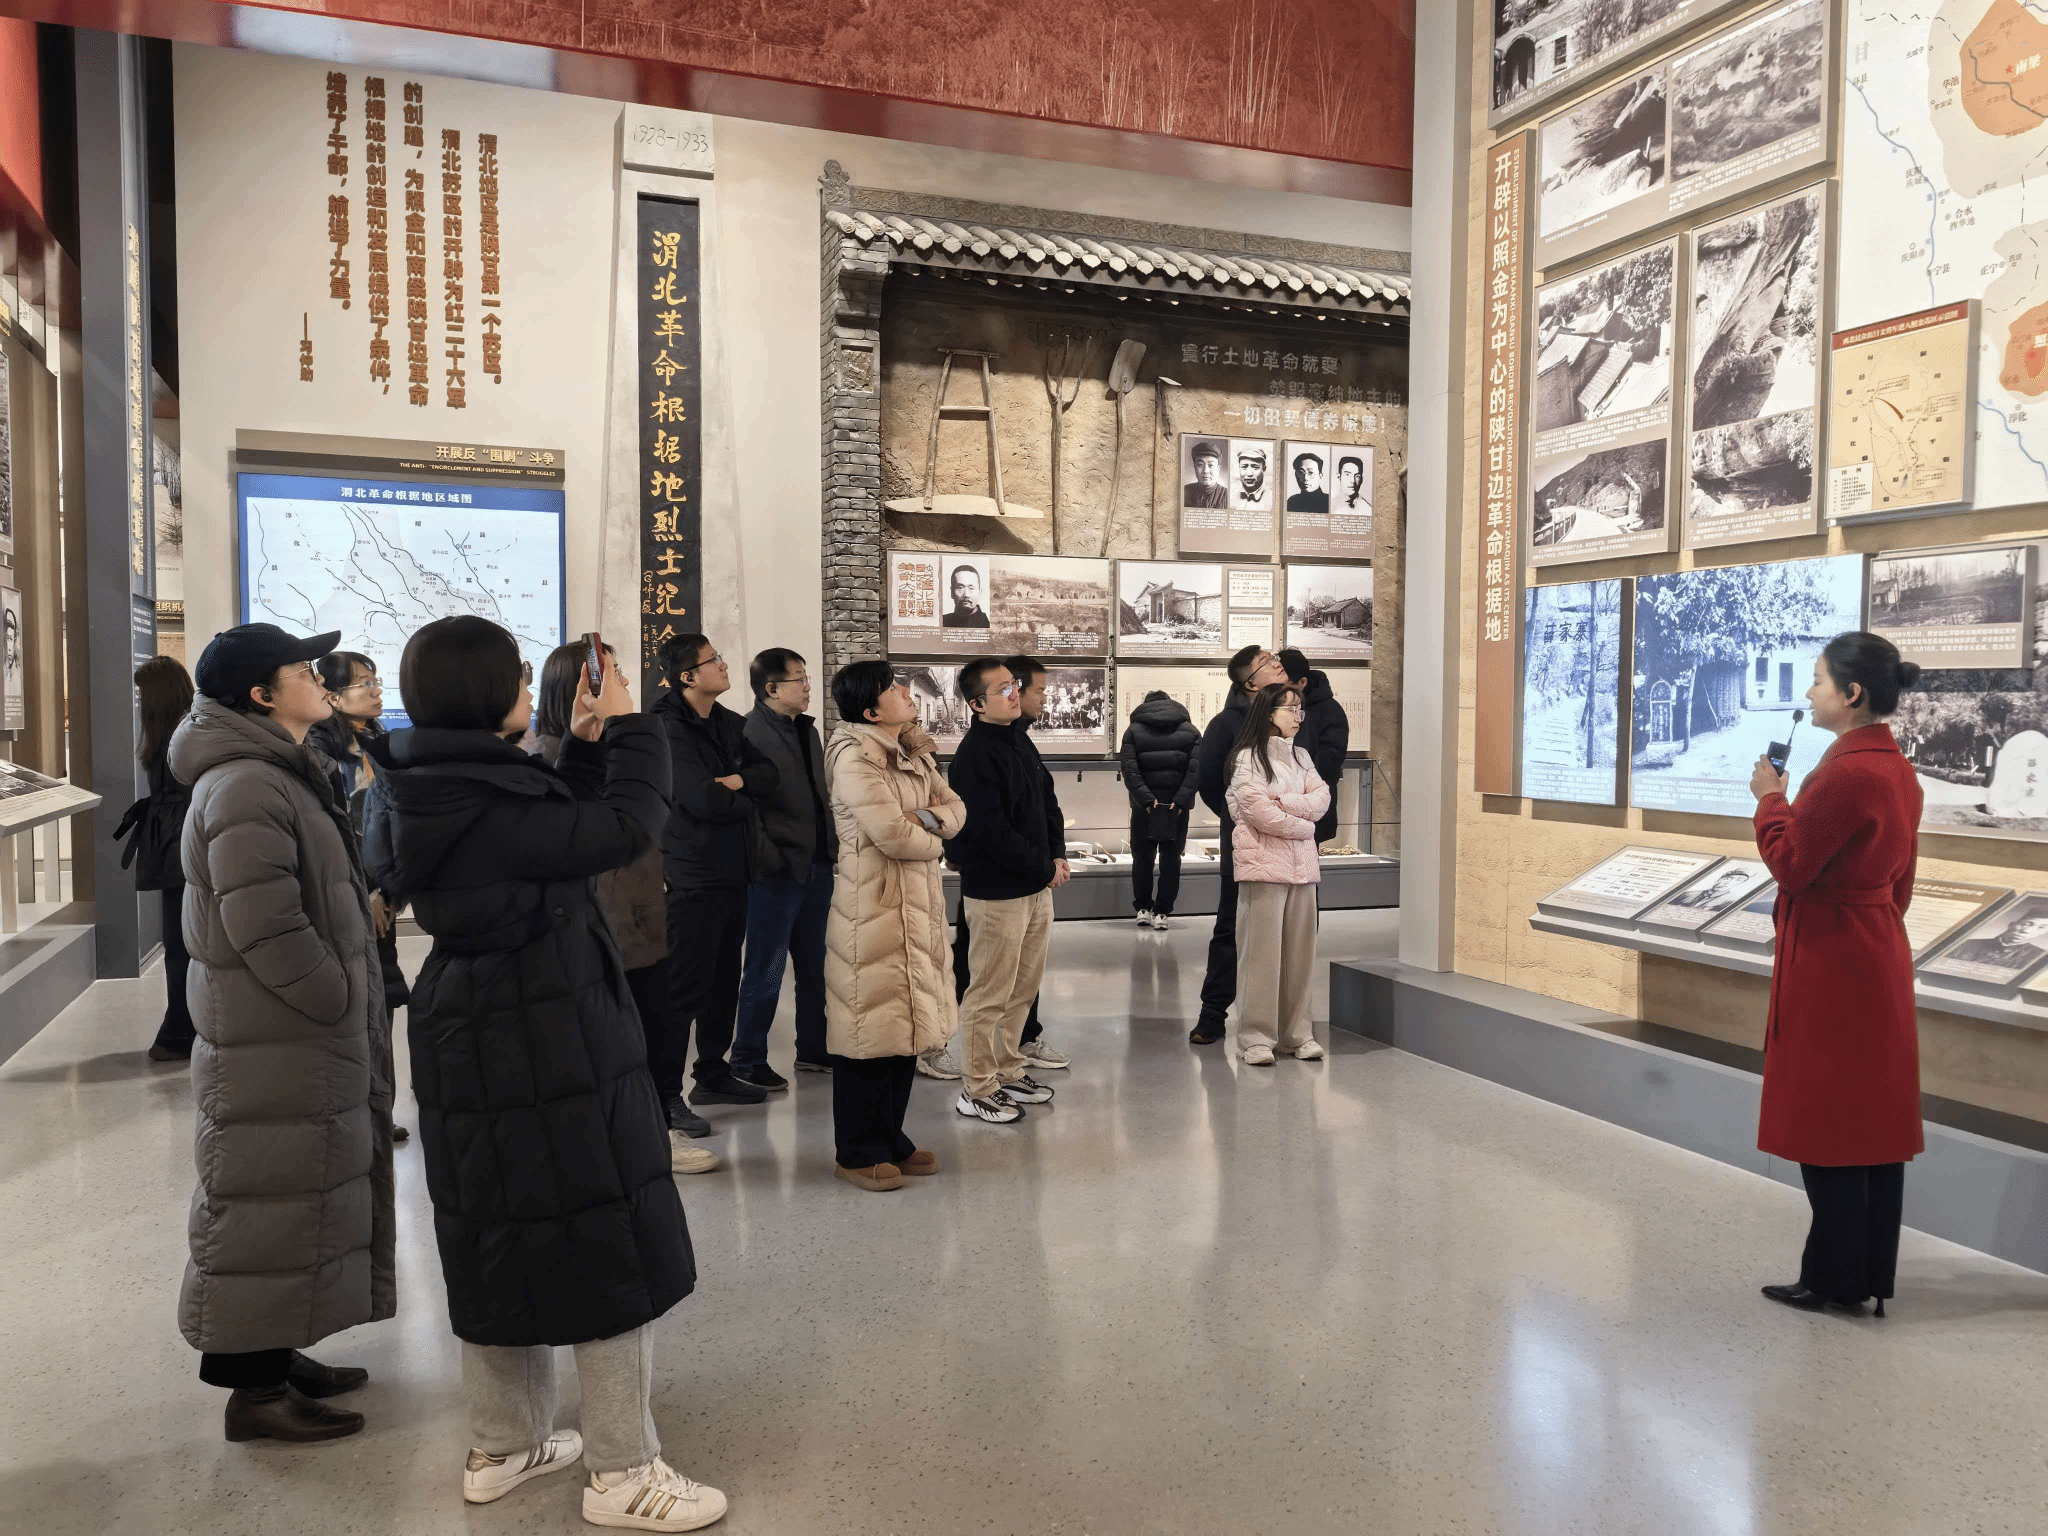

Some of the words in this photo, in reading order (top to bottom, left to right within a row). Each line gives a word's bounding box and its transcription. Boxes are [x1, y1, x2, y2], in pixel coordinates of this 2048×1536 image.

[633, 124, 709, 153] 1928-1933
[1512, 148, 1520, 227] ESTABLISHMENT
[1955, 206, 1973, 219] 合水
[1949, 216, 1976, 231] 西华池
[1511, 230, 1518, 242] OF
[1510, 245, 1518, 263] THE
[1934, 263, 1951, 276] 宁县
[1509, 266, 1517, 349] SHAANXI-GANSU
[1485, 151, 1512, 642] 开辟以照金为中心的陕甘边革命根据地
[1506, 393, 1514, 473] REVOLUTIONARY
[340, 486, 473, 504] 渭北革命根据地区域图
[1505, 476, 1513, 500] BASE
[1504, 529, 1512, 572] ZHAOJIN
[1504, 574, 1511, 586] AS
